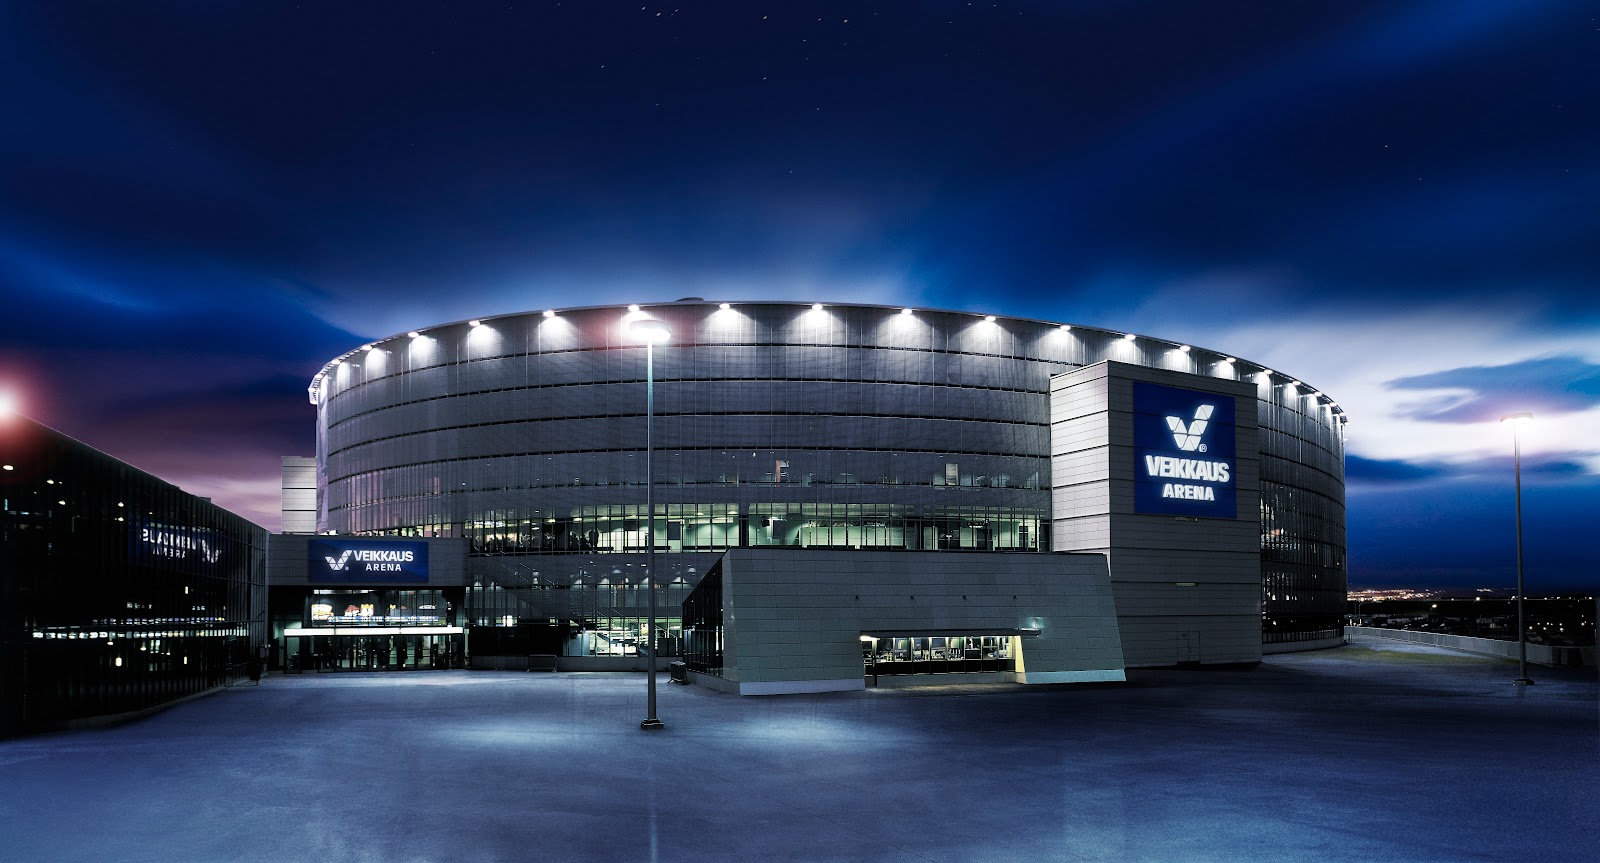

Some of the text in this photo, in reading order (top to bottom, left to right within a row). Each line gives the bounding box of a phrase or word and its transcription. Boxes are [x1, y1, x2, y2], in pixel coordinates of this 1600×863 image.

[1145, 455, 1230, 483] VEIKKAUS
[1163, 483, 1215, 501] ARENA
[353, 550, 414, 562] VEIKKAUS
[365, 563, 402, 572] ARENA
